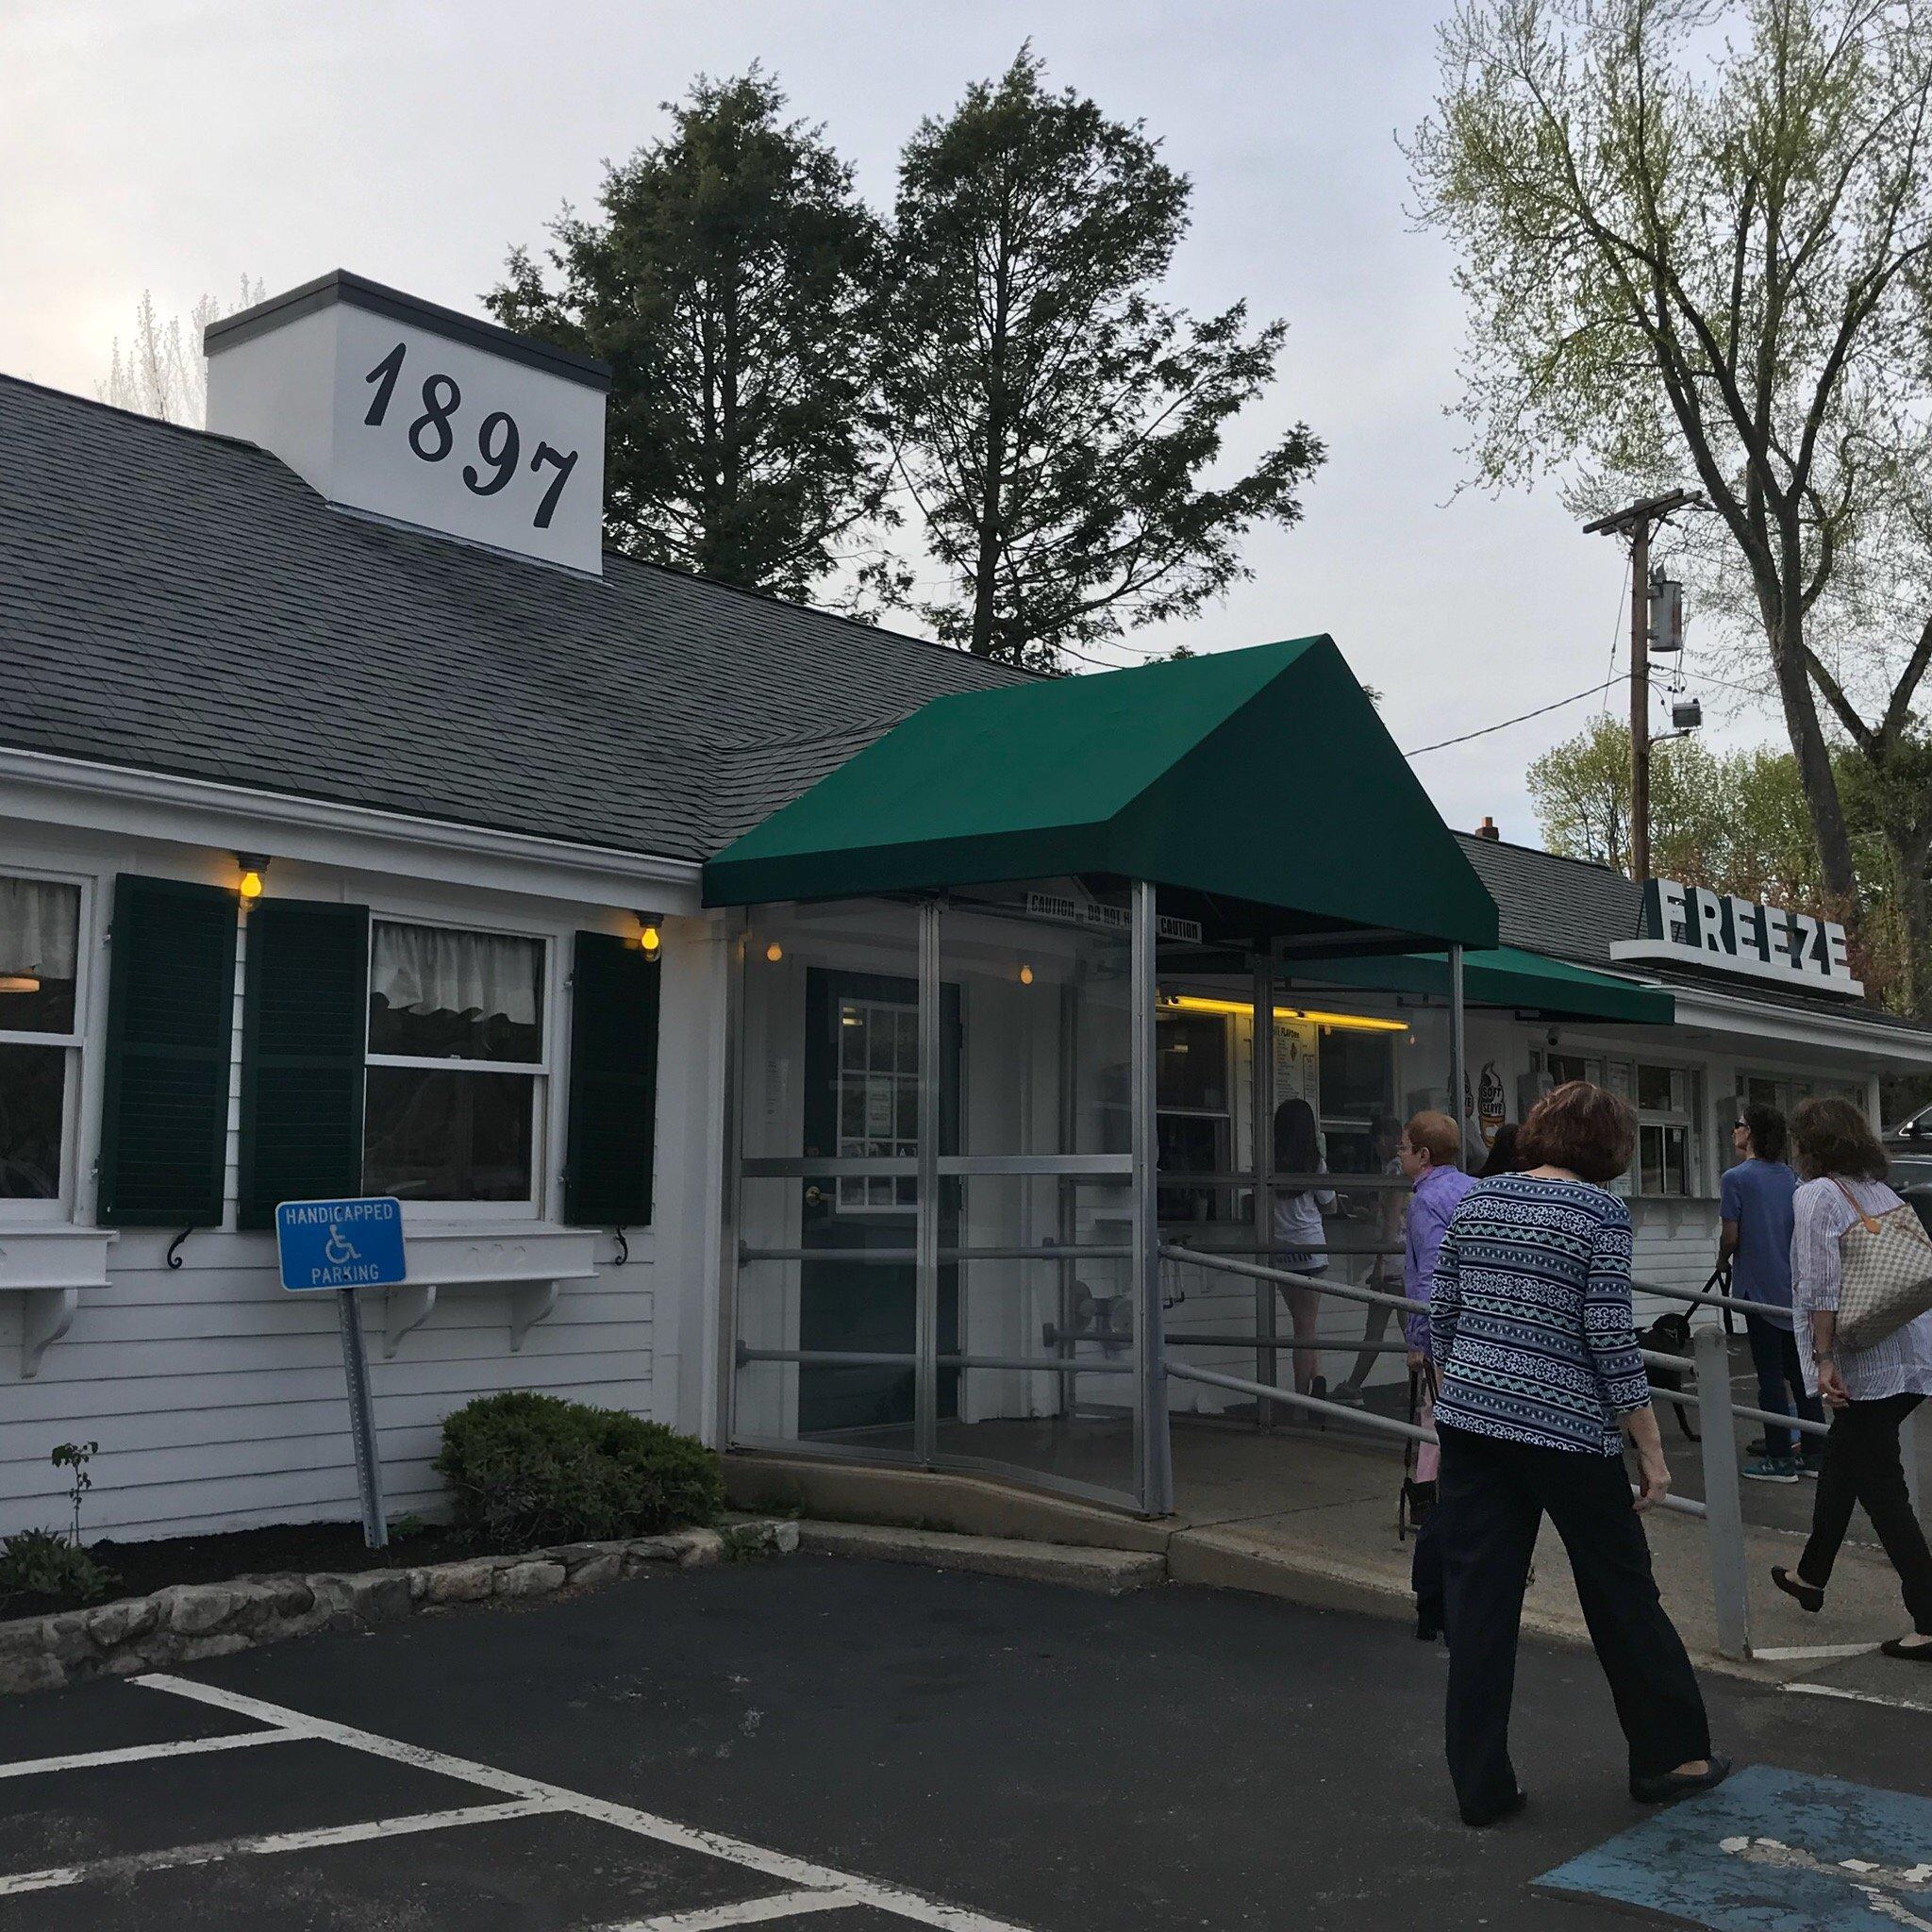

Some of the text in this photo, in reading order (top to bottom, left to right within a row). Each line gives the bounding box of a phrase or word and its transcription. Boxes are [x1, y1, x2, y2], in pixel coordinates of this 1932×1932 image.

[364, 342, 578, 528] 1897
[1031, 894, 1074, 917] CAUTION
[1088, 904, 1102, 923] DO
[1103, 908, 1121, 926] NOT
[1160, 918, 1198, 939] CAUTION
[1657, 878, 1851, 980] FREEZE
[1483, 1088, 1502, 1097] SOFT
[1483, 1104, 1502, 1114] SERVE
[286, 1204, 392, 1224] HANDICAPPED
[312, 1264, 379, 1284] PARKING
